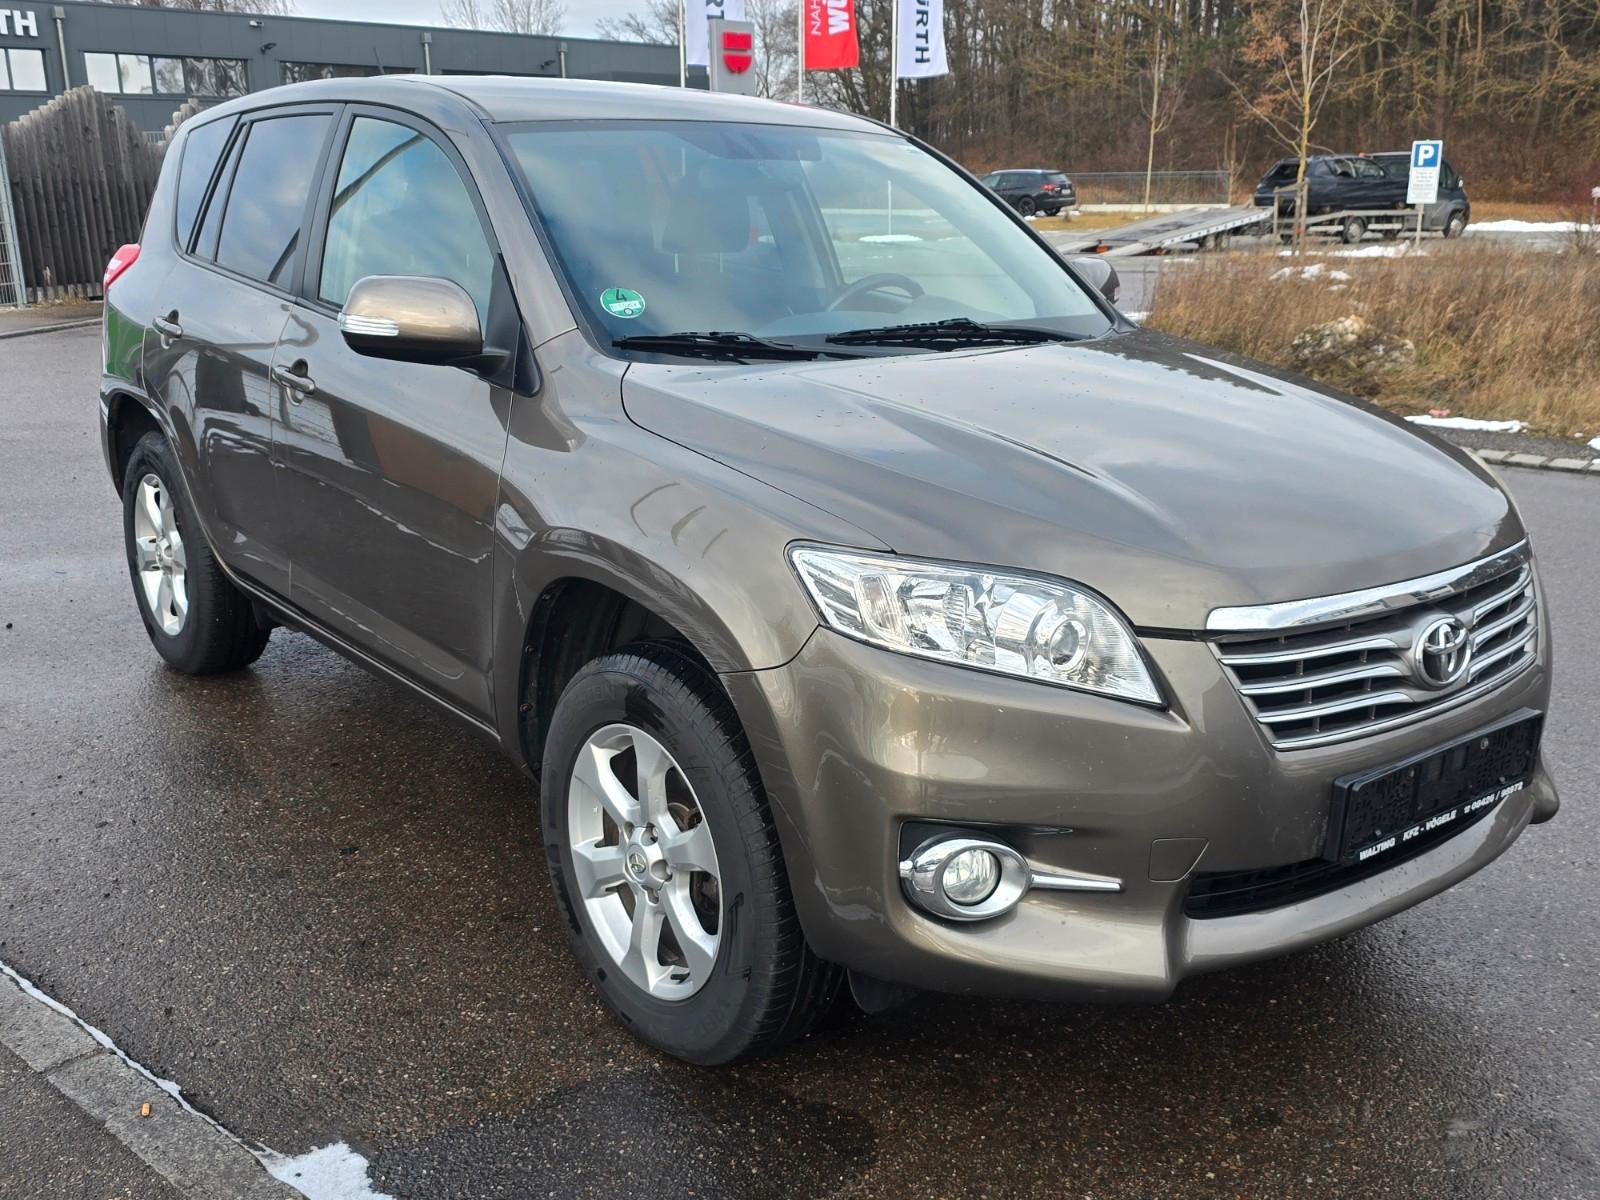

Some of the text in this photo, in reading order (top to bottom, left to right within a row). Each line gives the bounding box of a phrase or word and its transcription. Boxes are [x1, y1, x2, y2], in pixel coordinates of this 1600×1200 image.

[0, 8, 38, 37] TH
[1418, 144, 1435, 166] P
[616, 289, 627, 301] 4
[1359, 837, 1396, 861] WALTING
[1402, 825, 1420, 841] KFZ
